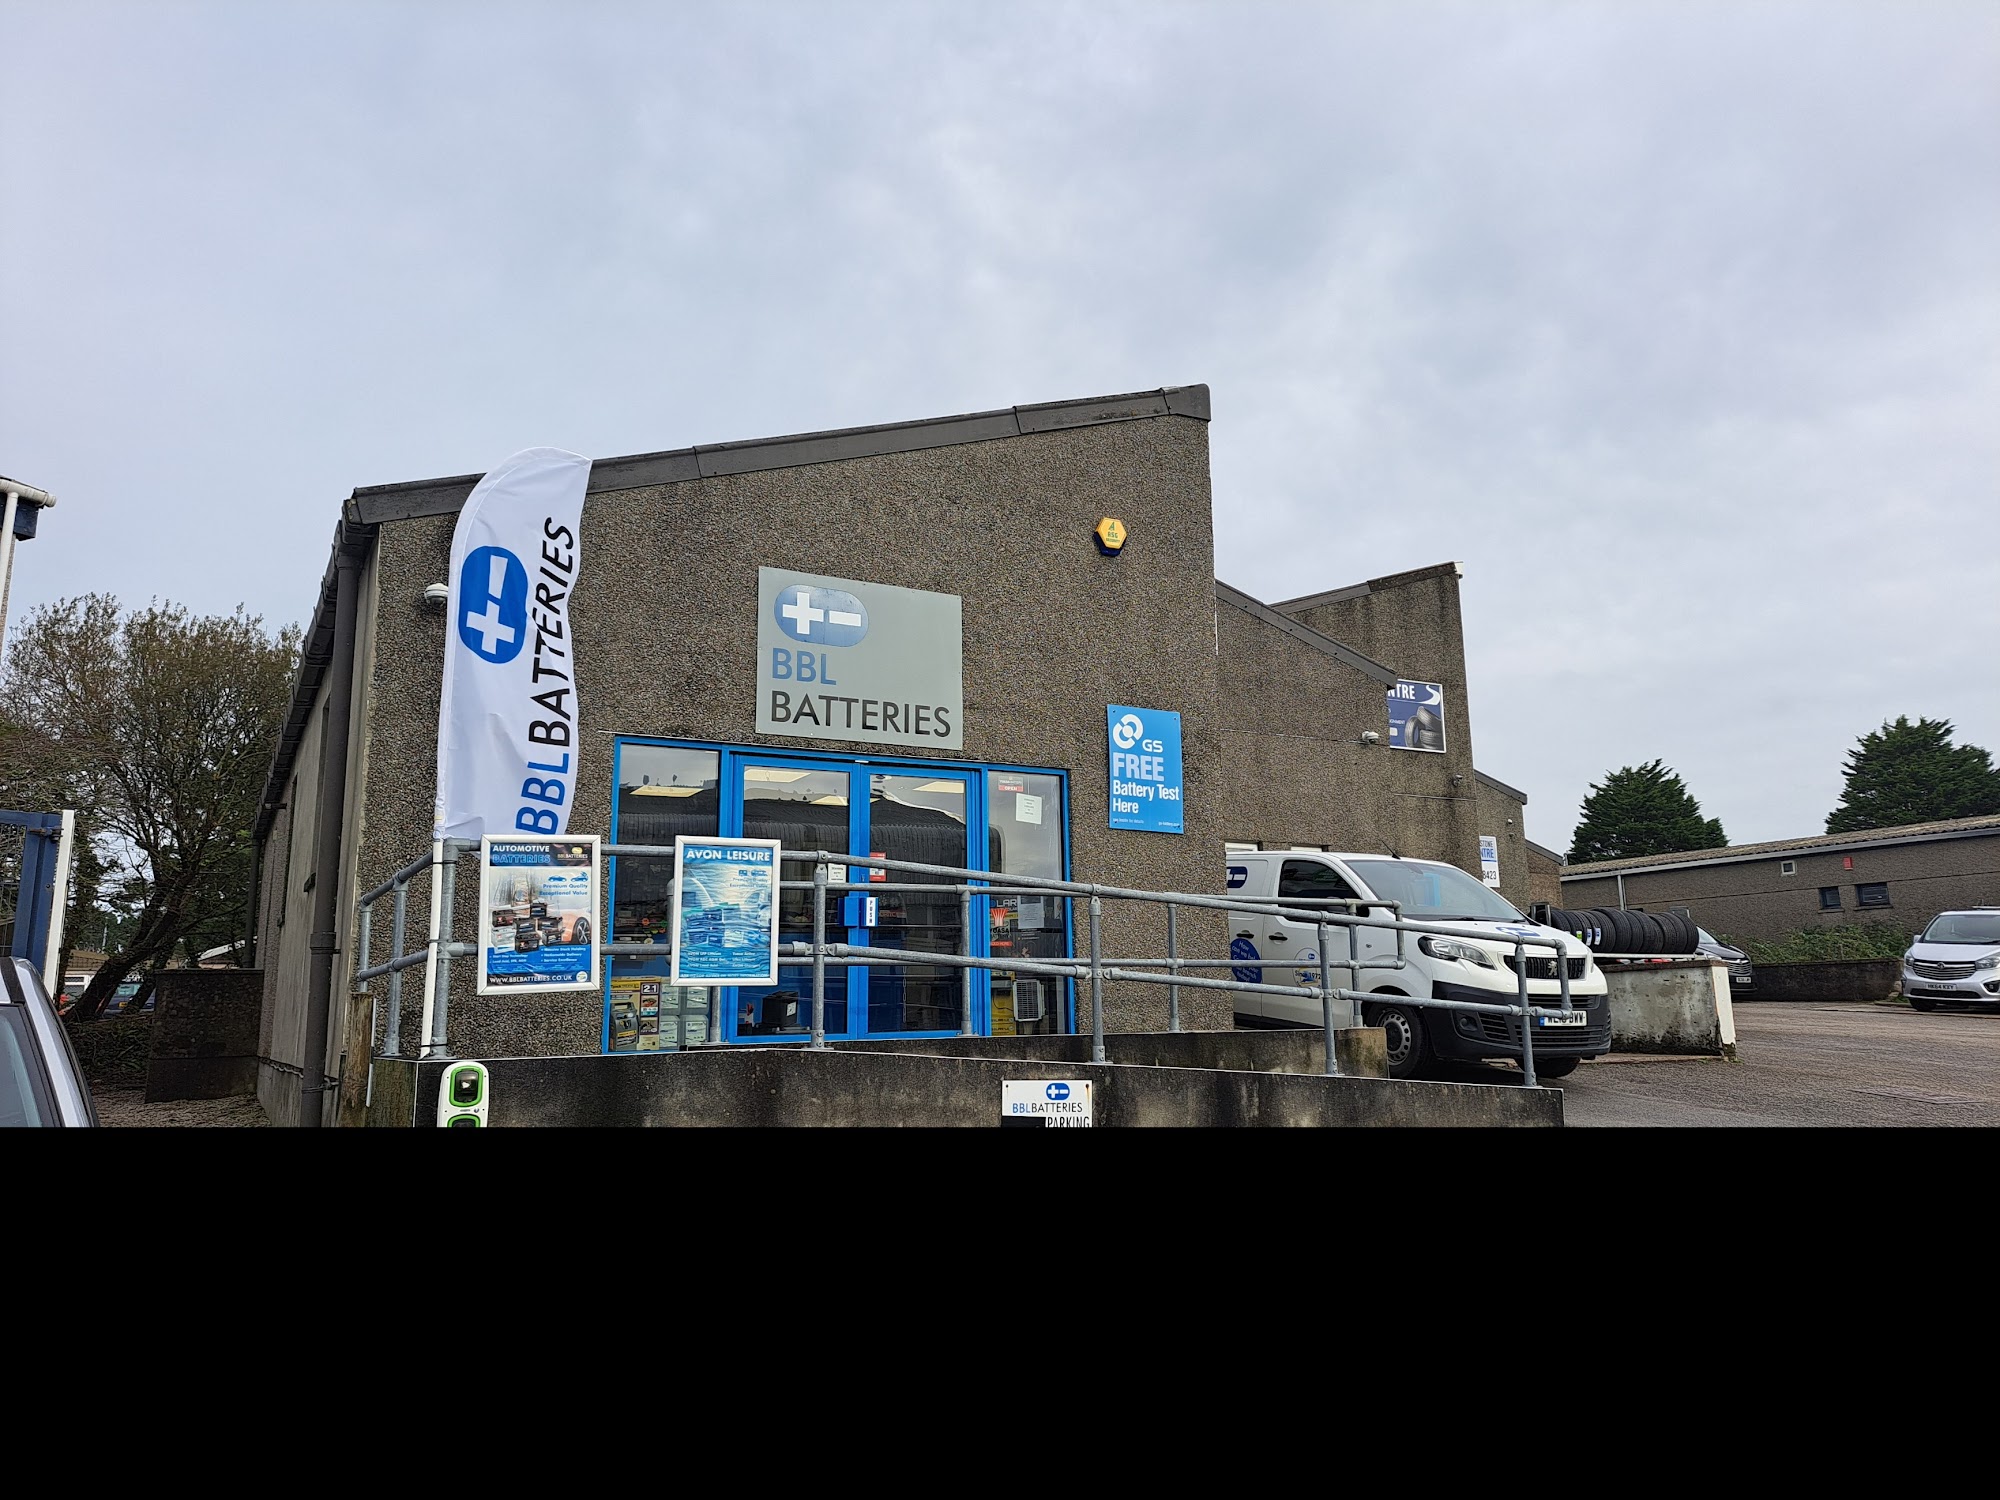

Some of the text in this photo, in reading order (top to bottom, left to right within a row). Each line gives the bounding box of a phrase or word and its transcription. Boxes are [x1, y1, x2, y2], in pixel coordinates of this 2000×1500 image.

[771, 647, 837, 686] BBL
[770, 690, 952, 738] BATTERIES
[1141, 739, 1164, 753] GS
[1112, 751, 1165, 782] FREE
[1112, 779, 1180, 802] Battery Test
[1112, 797, 1140, 814] Here
[492, 845, 550, 853] AUTOMOTIVE
[686, 849, 770, 861] AVON LEISURE
[491, 854, 551, 864] BATTERIES
[1048, 1116, 1090, 1128] PARKING
